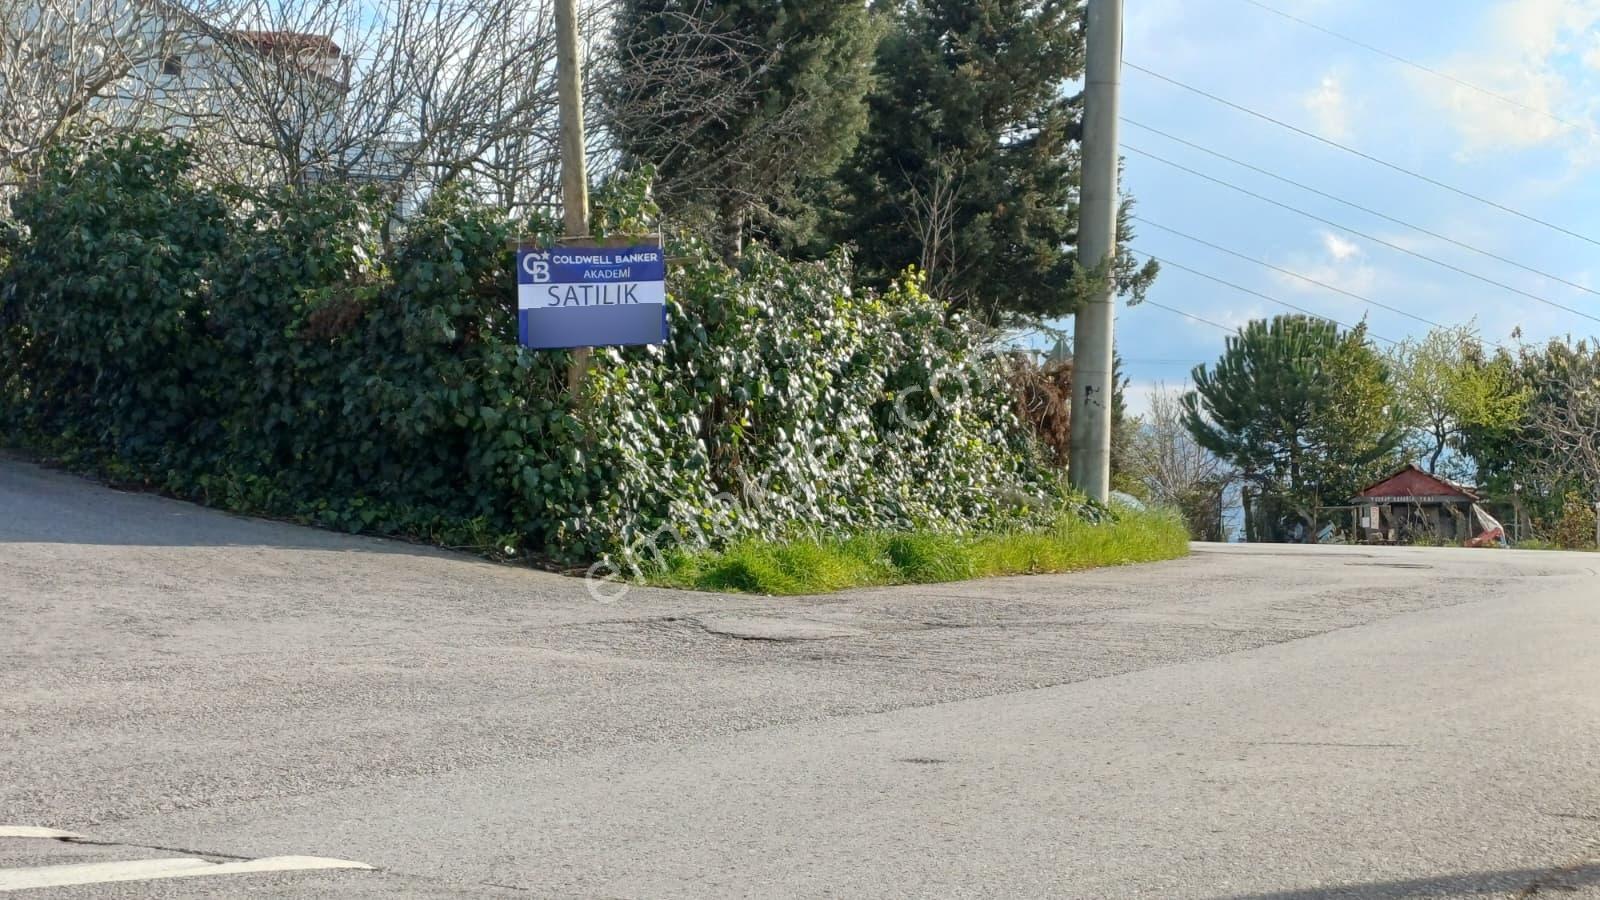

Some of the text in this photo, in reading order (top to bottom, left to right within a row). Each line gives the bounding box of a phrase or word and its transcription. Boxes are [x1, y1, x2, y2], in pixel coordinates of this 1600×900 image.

[552, 252, 658, 264] COLDWELL BANKER
[583, 267, 631, 279] AKADEMİ
[548, 284, 639, 306] SATILIK
